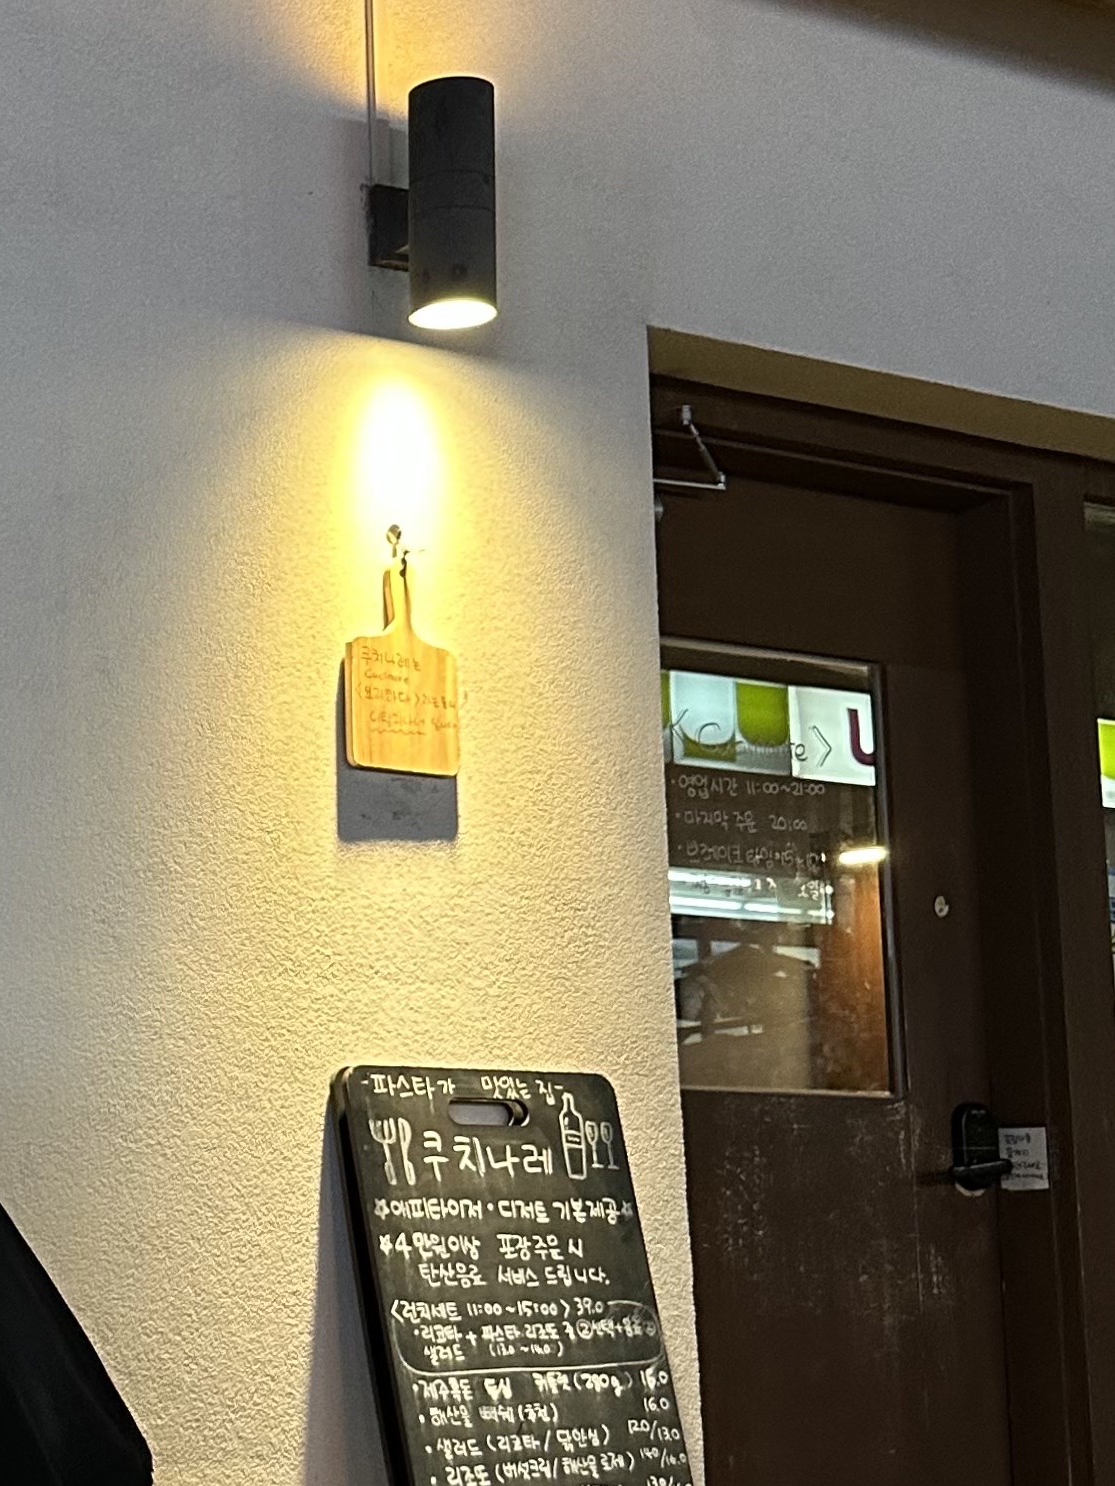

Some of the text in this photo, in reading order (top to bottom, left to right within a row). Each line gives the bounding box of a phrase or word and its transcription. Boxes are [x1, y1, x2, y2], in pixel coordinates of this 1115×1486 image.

[481, 1075, 531, 1100] 맛있는
[423, 1130, 554, 1183] 쿠치나레
[418, 1262, 487, 1289] 탄산음료
[498, 1264, 540, 1287] 서비스
[424, 1343, 466, 1366] 샐러드
[429, 1404, 474, 1428] 해산물
[437, 1437, 483, 1461] 샐러드
